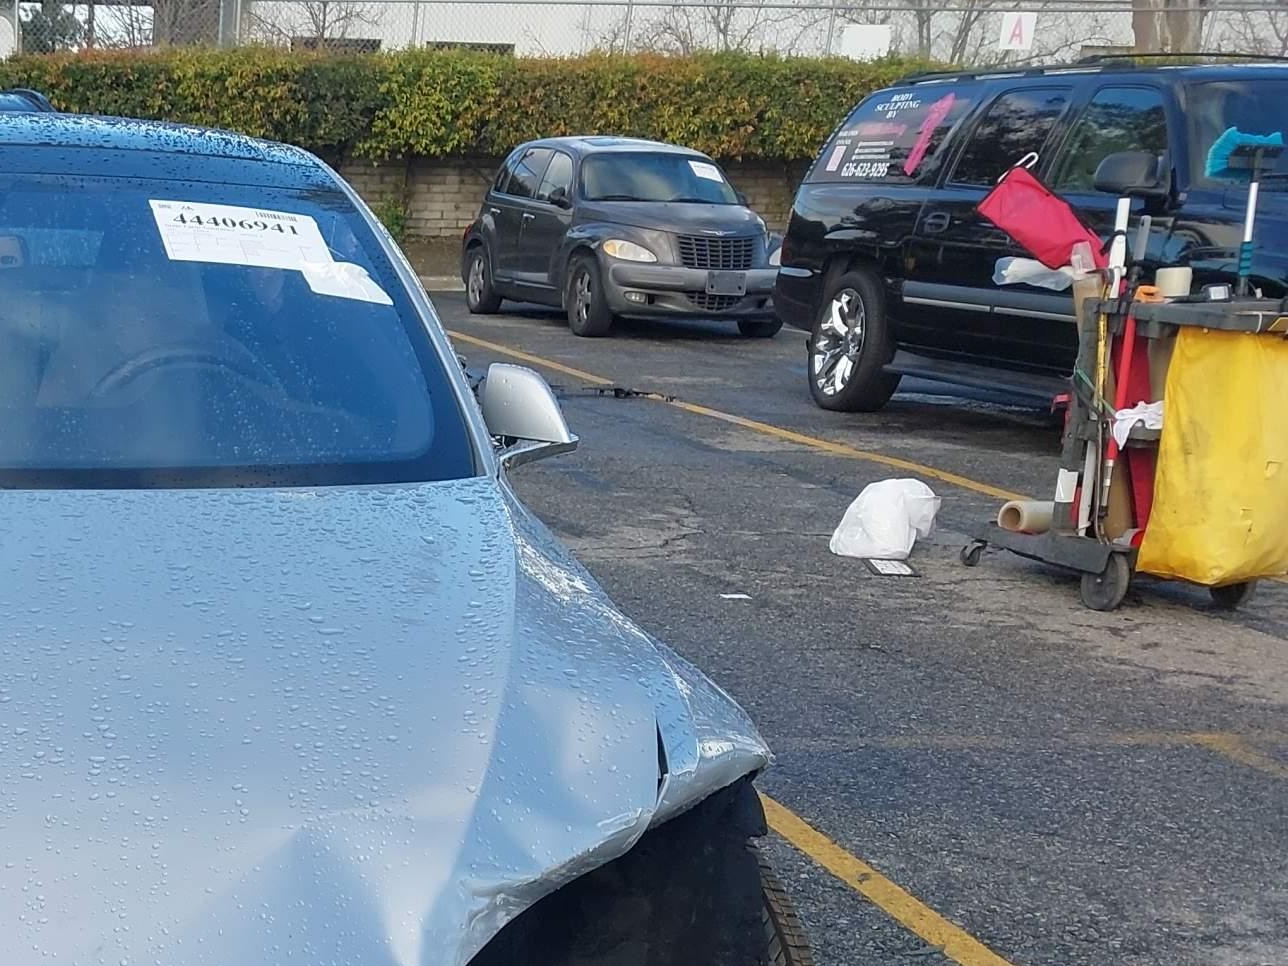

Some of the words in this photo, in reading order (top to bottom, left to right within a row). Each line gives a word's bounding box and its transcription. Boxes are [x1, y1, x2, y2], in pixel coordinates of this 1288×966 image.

[1008, 16, 1023, 45] A
[874, 100, 921, 112] SCULPTING
[841, 162, 891, 177] 626-623-9295
[173, 212, 300, 236] 44406941
